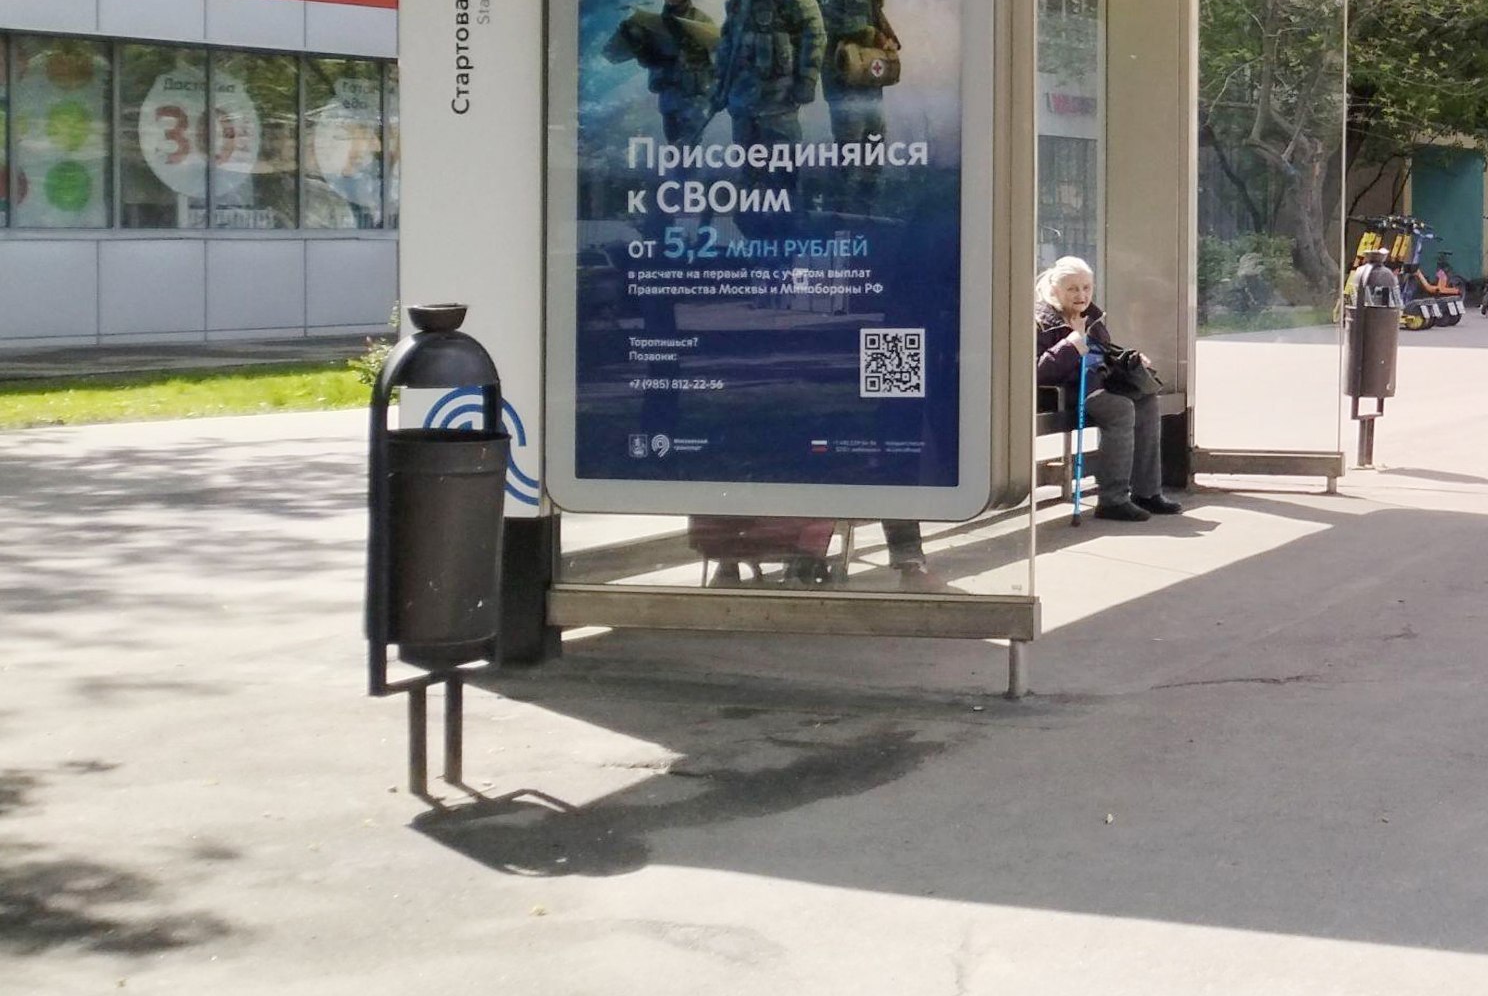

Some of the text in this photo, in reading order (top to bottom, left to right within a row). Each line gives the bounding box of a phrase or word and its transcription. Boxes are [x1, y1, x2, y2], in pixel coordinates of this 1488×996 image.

[628, 134, 929, 175] Присоединяйся
[628, 181, 791, 214] к СВОим
[663, 225, 718, 263] 5,2
[726, 240, 778, 258] МЛН
[784, 235, 869, 258] РУБЛЕЙ
[687, 270, 700, 278] на
[703, 269, 748, 281] первый
[751, 269, 770, 280] год
[773, 270, 779, 278] с
[827, 269, 871, 278] выплат
[628, 284, 883, 297] Правительства Москвы и Минобороны РФ
[629, 337, 698, 348] Торопишься?
[629, 351, 678, 361] Позвони:
[642, 380, 669, 390] (985)
[672, 380, 723, 389] 812-22-56
